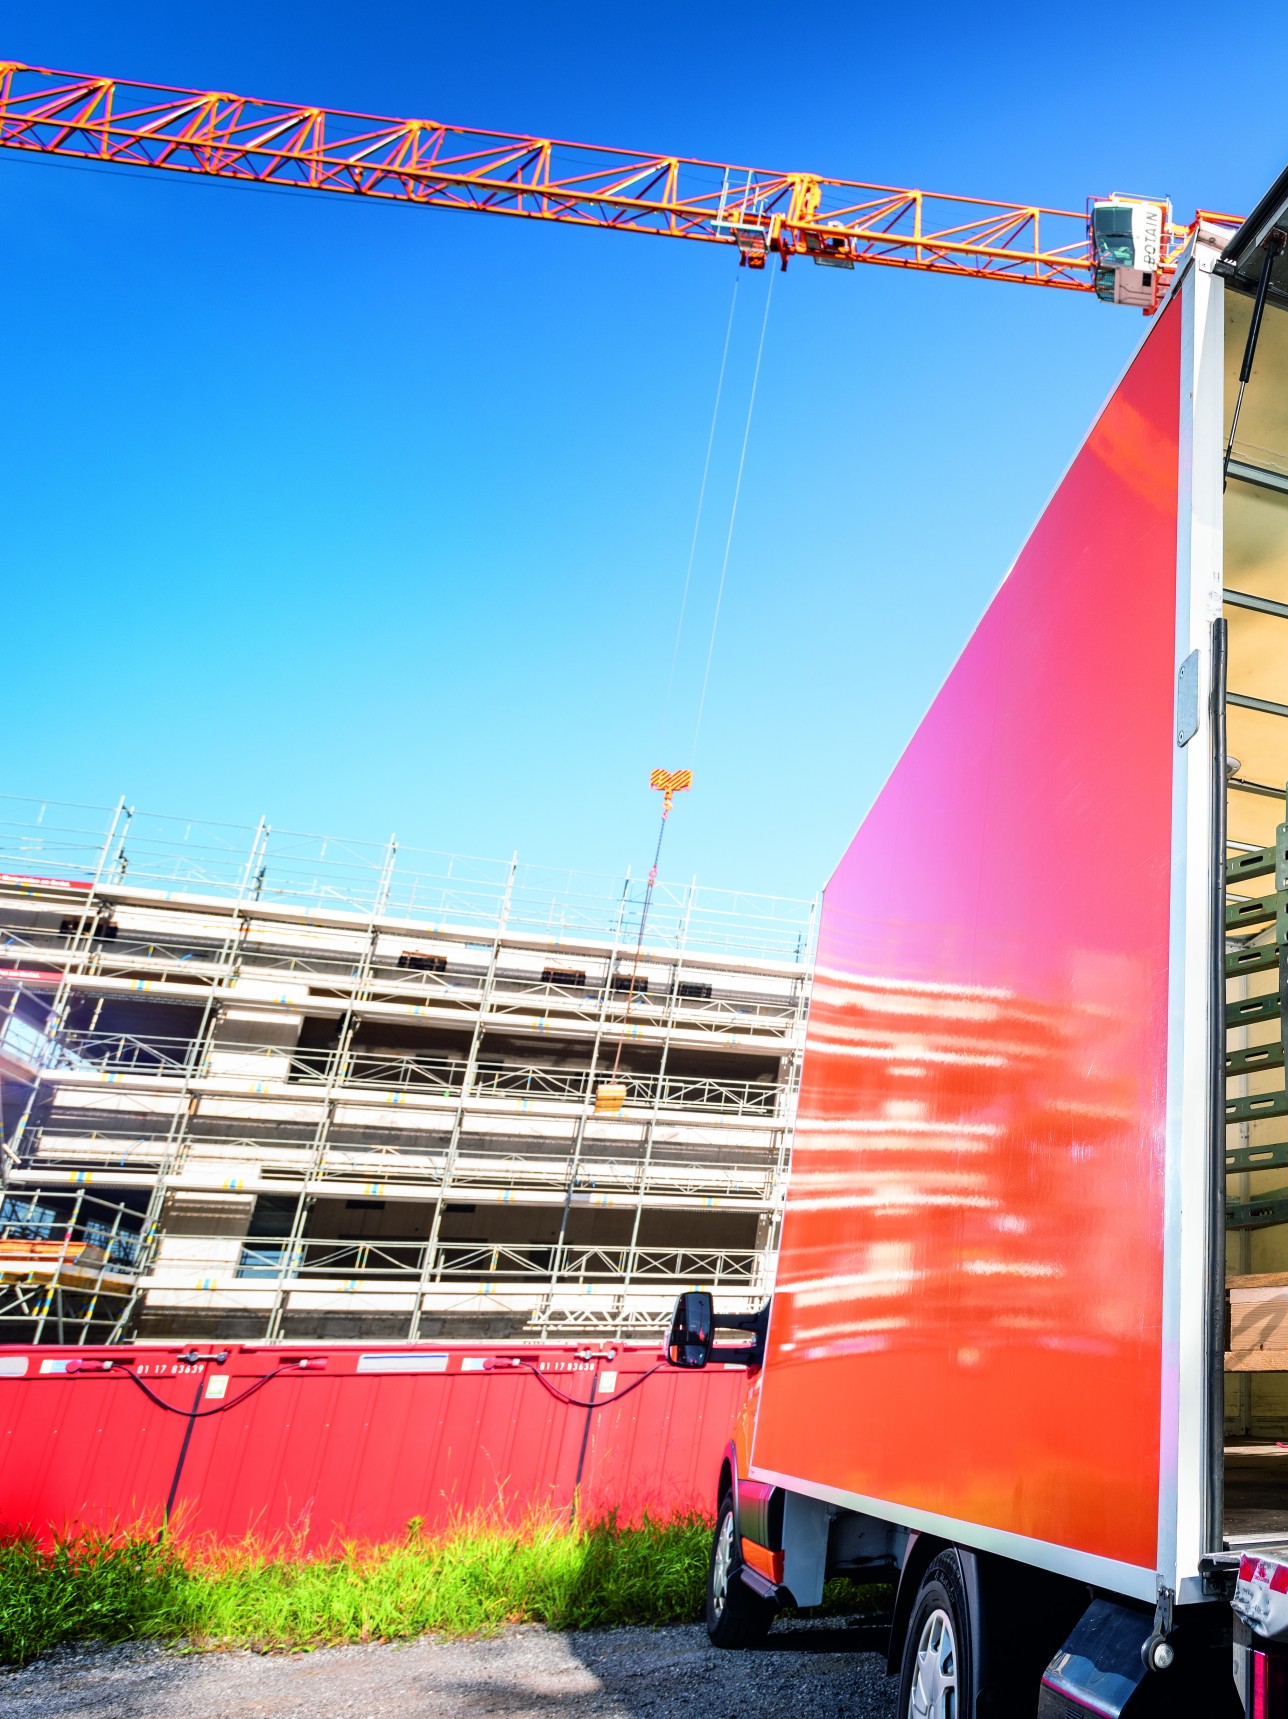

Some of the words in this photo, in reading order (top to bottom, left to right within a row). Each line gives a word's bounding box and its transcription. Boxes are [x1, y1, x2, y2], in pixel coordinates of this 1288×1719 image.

[136, 1364, 150, 1375] 01
[154, 1364, 167, 1375] 17
[170, 1364, 205, 1374] 83639
[539, 1361, 551, 1371] 01
[554, 1361, 566, 1371] 17
